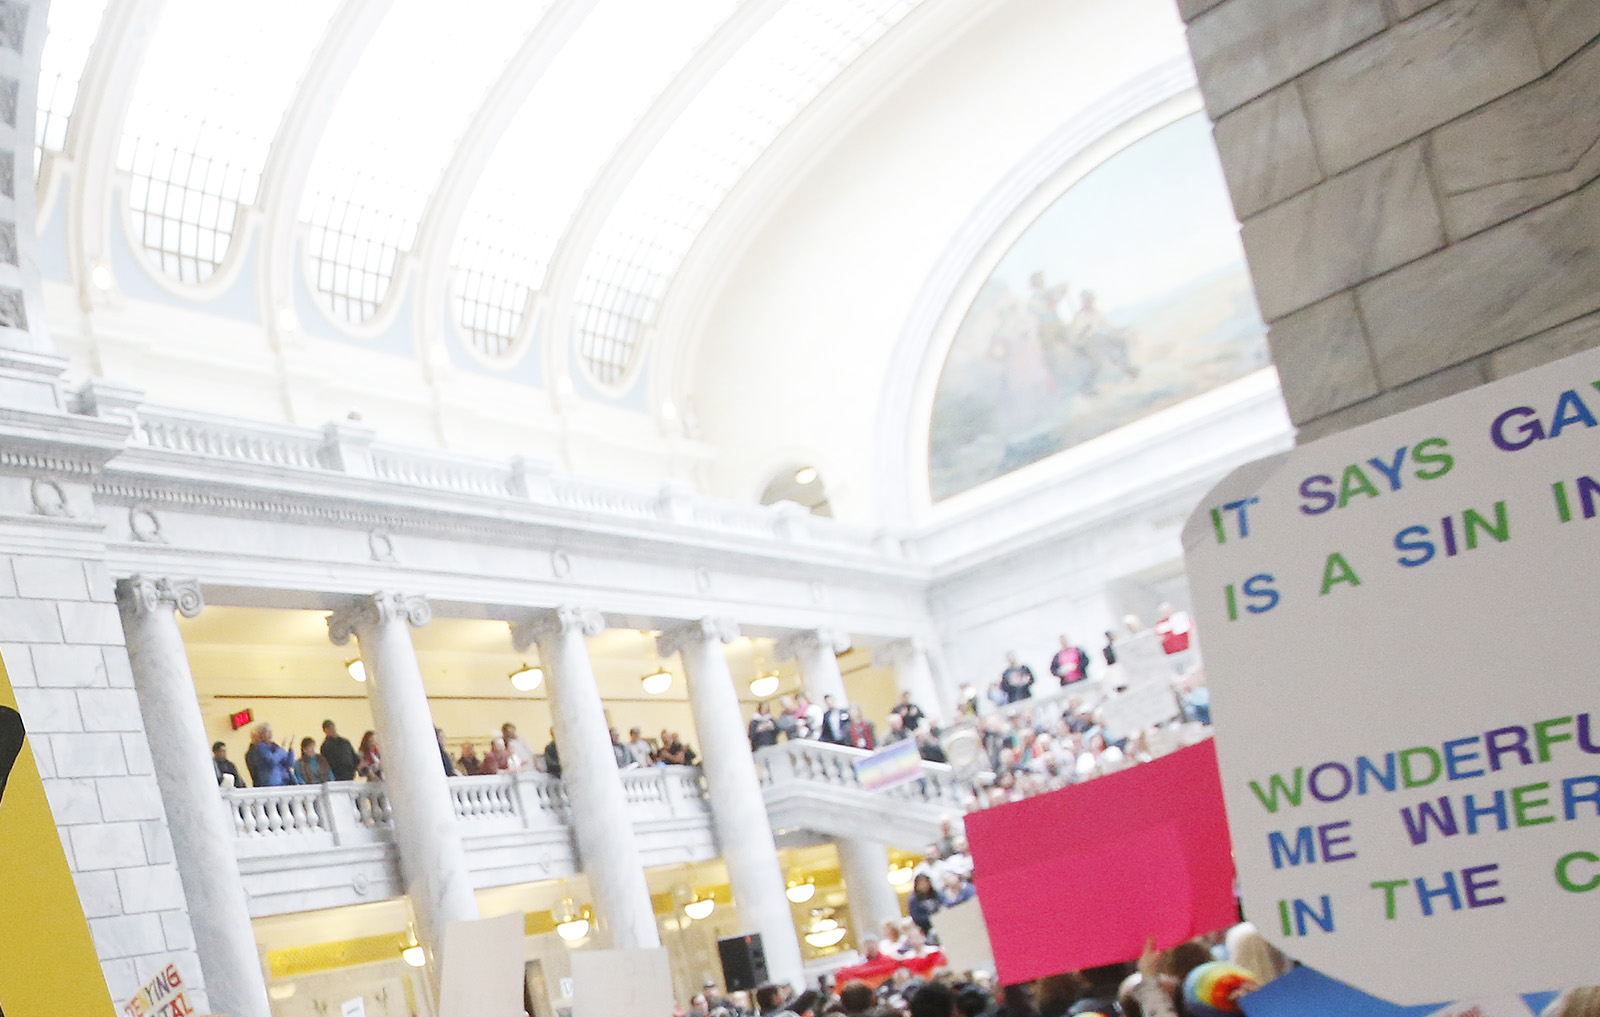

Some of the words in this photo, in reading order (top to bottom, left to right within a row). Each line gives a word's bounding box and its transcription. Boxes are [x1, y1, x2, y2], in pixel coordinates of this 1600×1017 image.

[1210, 497, 1259, 544] IT
[1299, 437, 1455, 515] SAYS
[1490, 379, 1600, 452] GA
[1225, 573, 1280, 622] IS
[1320, 552, 1362, 596] A
[1393, 501, 1511, 567] SIN
[1267, 820, 1357, 870] ME
[1278, 895, 1335, 937] IN
[1370, 863, 1506, 921] THE
